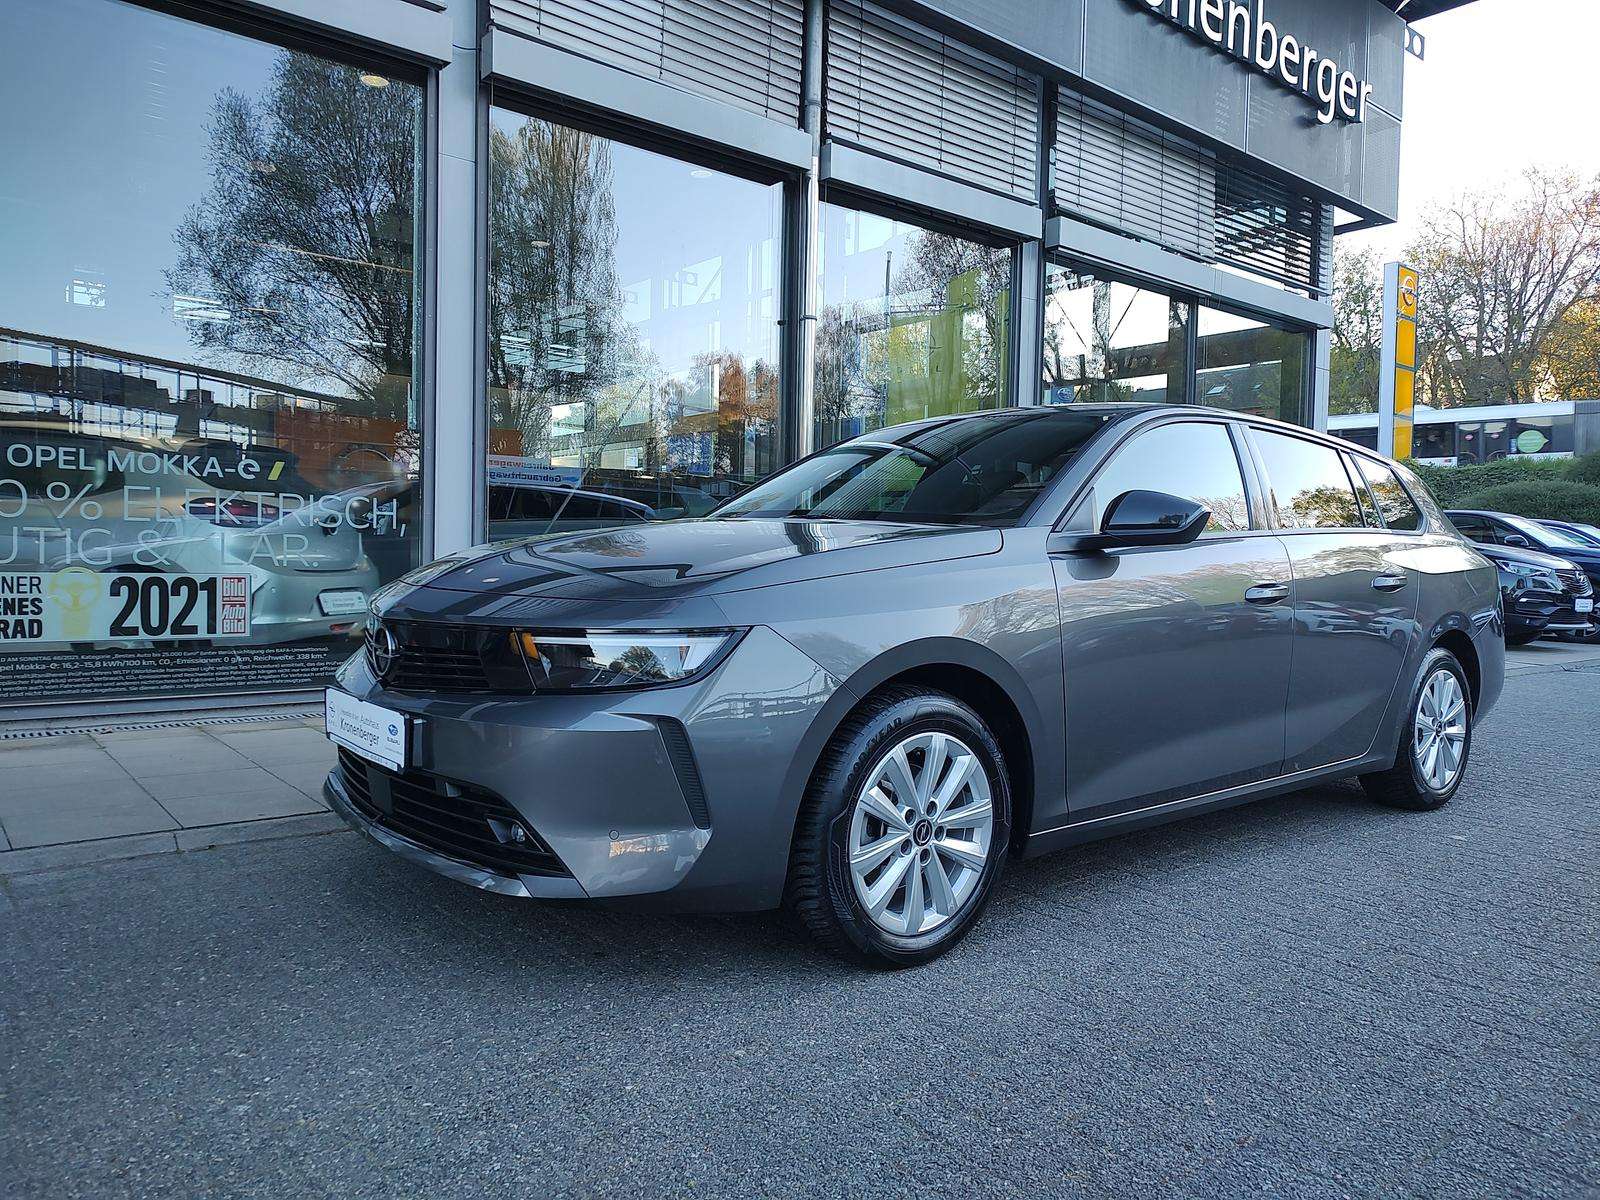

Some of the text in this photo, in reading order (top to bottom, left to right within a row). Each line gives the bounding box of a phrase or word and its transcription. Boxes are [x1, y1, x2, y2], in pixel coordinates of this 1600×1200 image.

[1143, 0, 1373, 124] enberger
[6, 443, 97, 471] OPEL
[46, 481, 104, 521] %
[123, 485, 407, 538] ELEKTRISCH,
[132, 529, 172, 567] &
[1, 575, 42, 594] NER
[0, 597, 43, 616] NES
[109, 576, 218, 636] 2021
